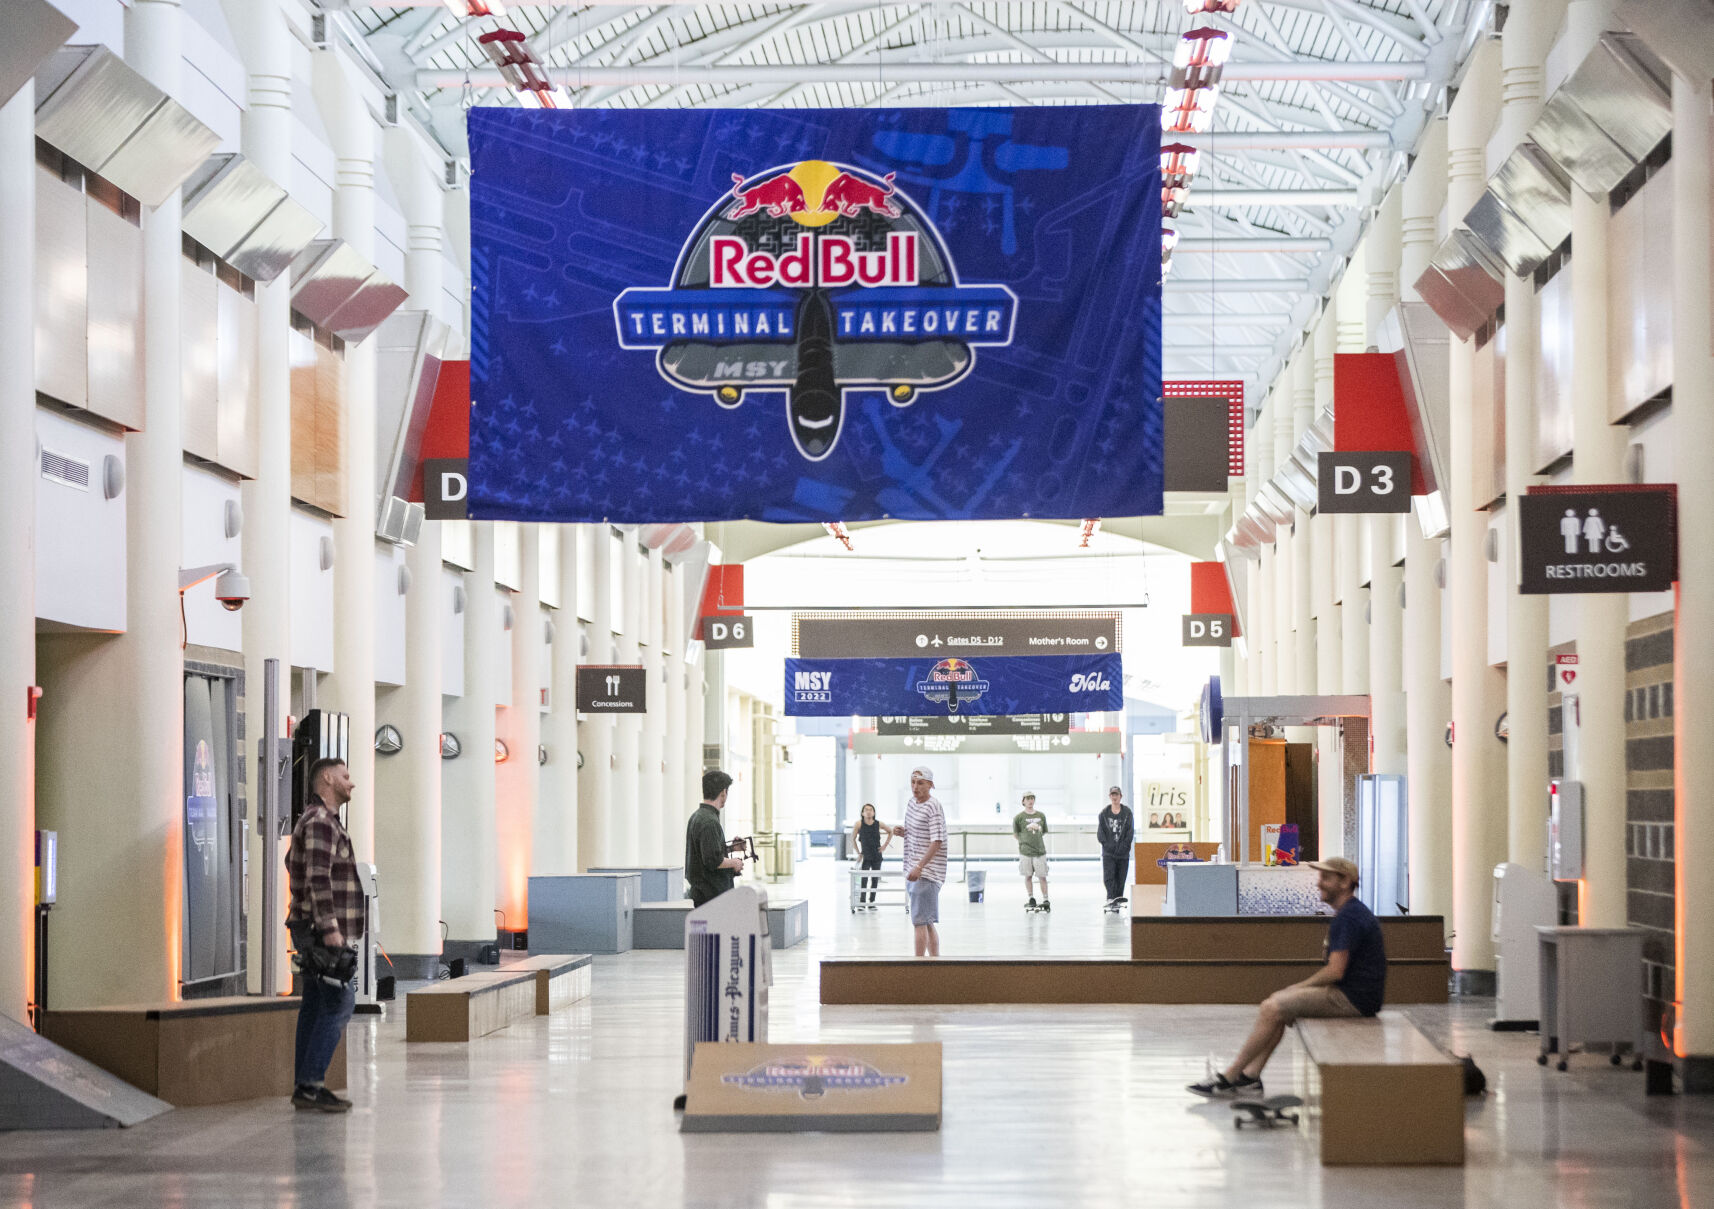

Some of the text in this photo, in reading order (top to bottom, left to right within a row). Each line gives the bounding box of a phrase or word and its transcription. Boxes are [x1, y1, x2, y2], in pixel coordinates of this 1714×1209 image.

[711, 233, 918, 287] Red Bull
[631, 309, 1001, 334] TERMINAL TAKEOVER
[713, 360, 788, 378] MSY
[441, 472, 468, 501] D
[1334, 465, 1394, 495] D 3
[1545, 562, 1647, 579] RESTROOMS
[712, 622, 745, 640] D 6
[1190, 620, 1223, 638] D 5
[947, 636, 968, 645] Gates
[970, 636, 981, 645] D5
[987, 636, 1003, 645] D12
[1029, 637, 1089, 646] Mother's Room
[794, 671, 832, 690] MSY
[934, 670, 973, 681] Red Bull
[1068, 672, 1111, 693] Nola
[592, 700, 634, 708] Concessions
[800, 692, 826, 700] 2022
[1150, 786, 1187, 806] iris
